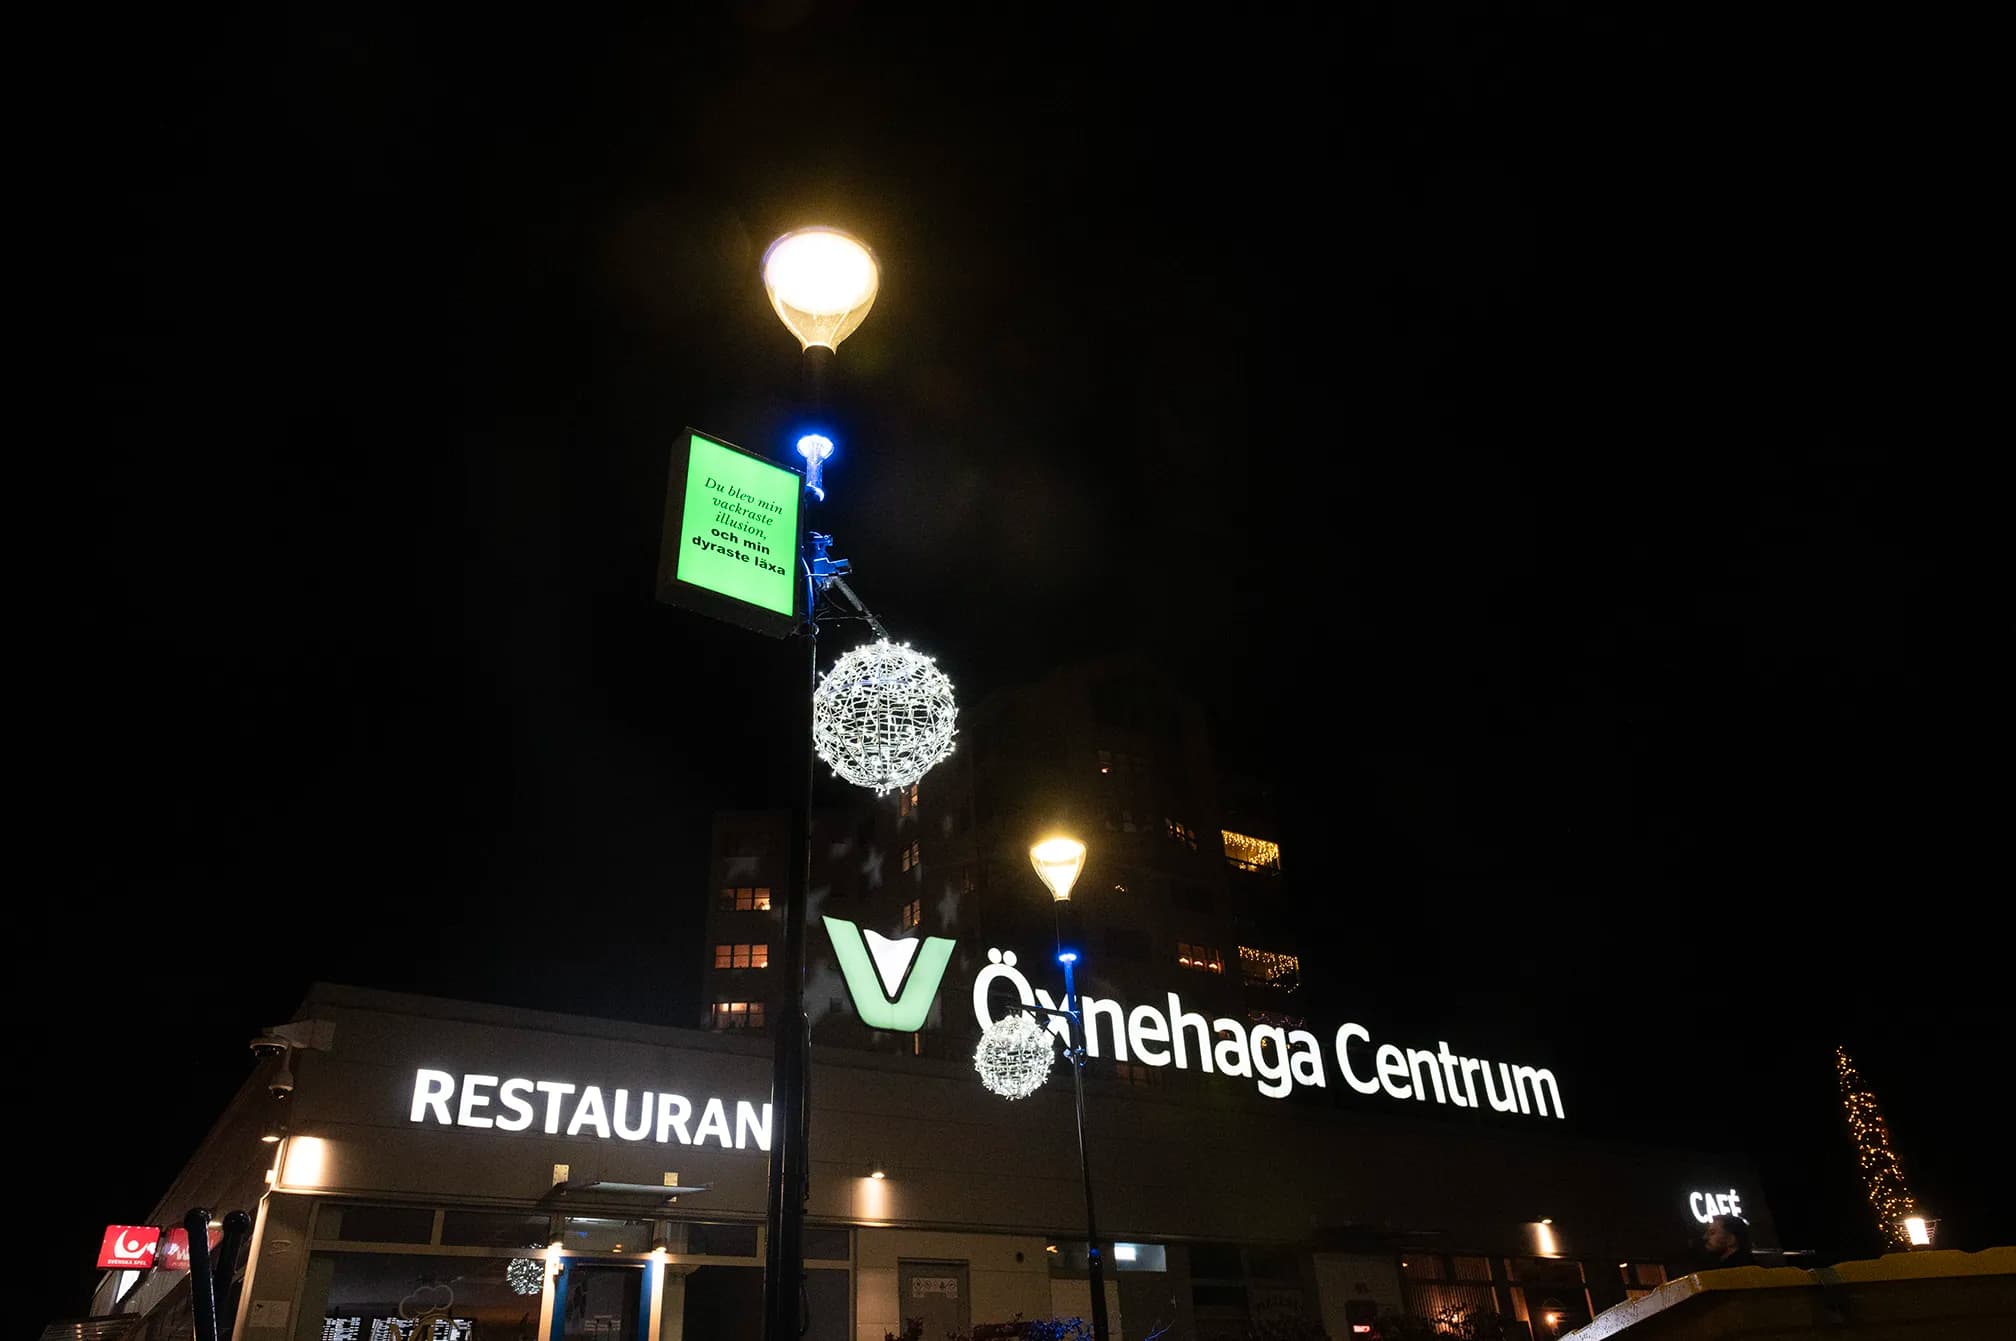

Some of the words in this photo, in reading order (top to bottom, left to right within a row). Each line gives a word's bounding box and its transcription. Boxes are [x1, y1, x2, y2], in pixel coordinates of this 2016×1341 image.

[704, 477, 725, 493] Du
[728, 485, 755, 504] blev
[757, 500, 783, 515] min
[712, 497, 774, 526] vackraste
[711, 527, 738, 544] och
[743, 539, 770, 555] min
[715, 511, 768, 540] illusion,
[692, 535, 750, 563] dyraste
[754, 556, 786, 576] läxa
[973, 948, 1327, 1099] Öxnehaga
[1335, 1022, 1566, 1120] Centrum
[409, 1068, 772, 1152] RESTAURAN
[1689, 1188, 1750, 1226] CAFÉ
